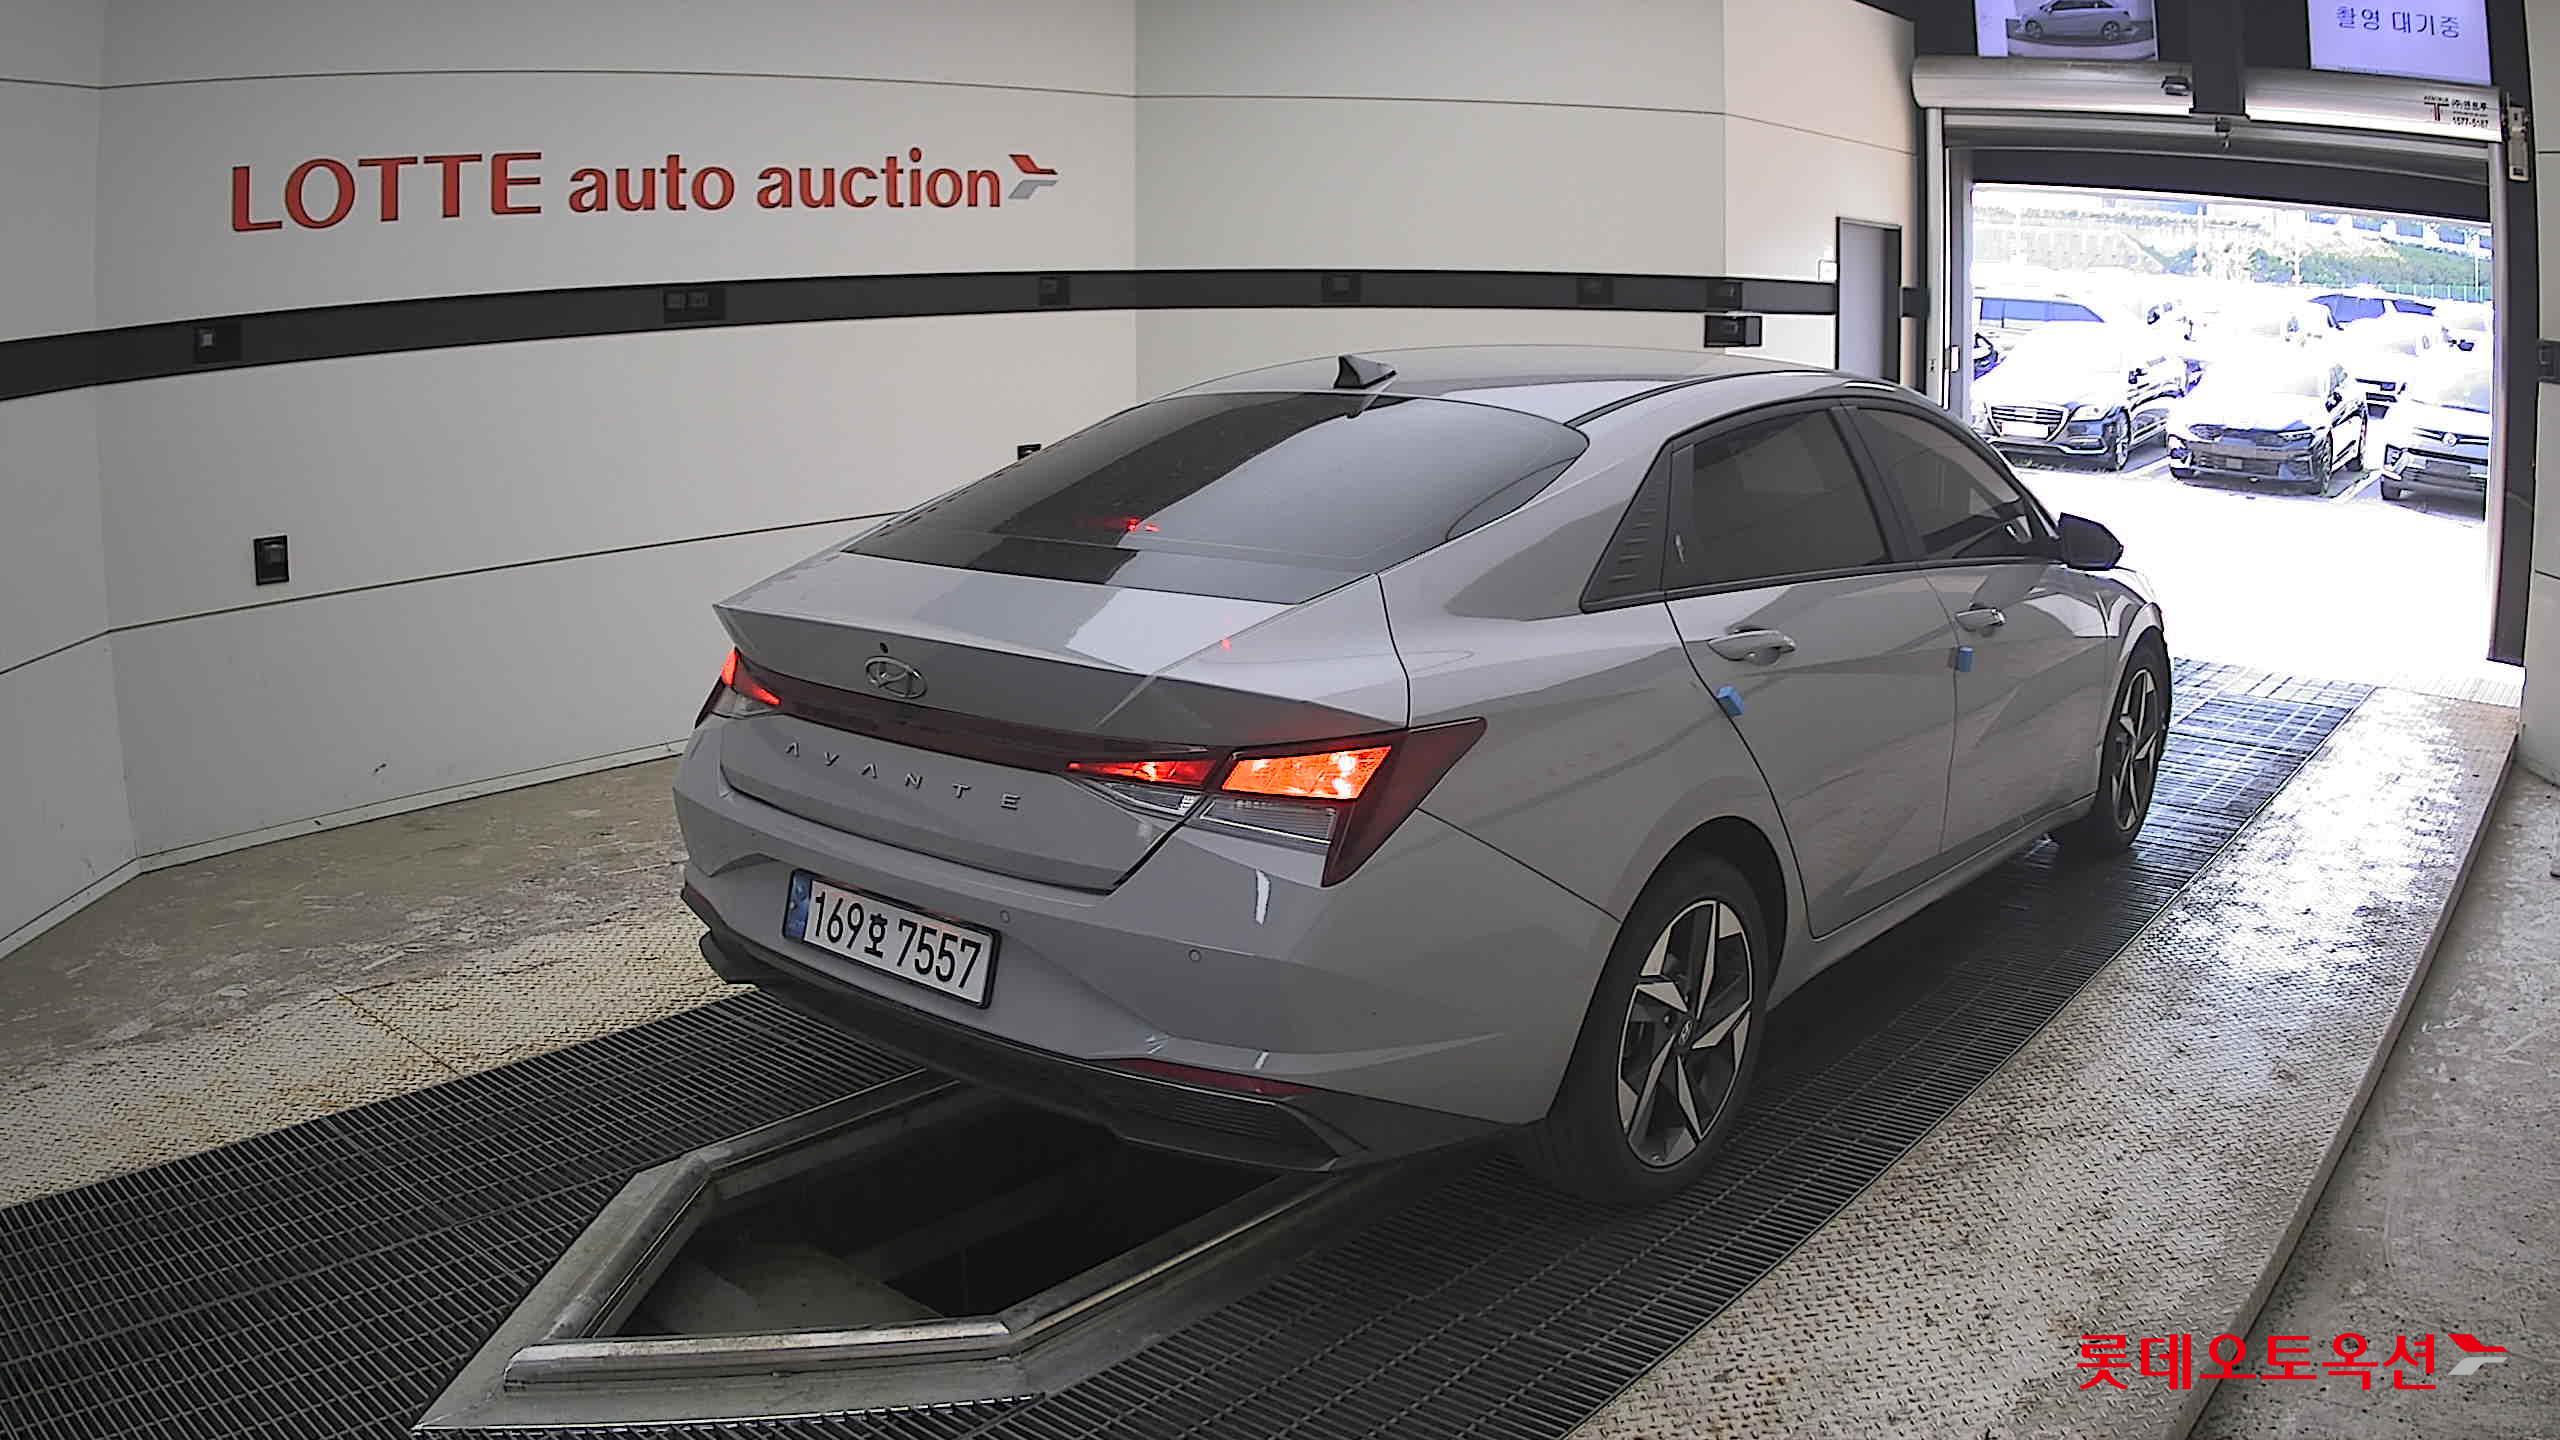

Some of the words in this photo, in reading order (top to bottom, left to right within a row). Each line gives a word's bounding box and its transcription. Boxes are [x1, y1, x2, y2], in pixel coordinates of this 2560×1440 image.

[2336, 6, 2380, 31] 촬영
[2391, 11, 2460, 39] 대기중
[232, 151, 543, 233] LOTTE
[570, 155, 736, 212] auto
[756, 147, 1001, 209] auction
[785, 741, 1021, 811] AVANTE
[896, 918, 982, 989] 7557
